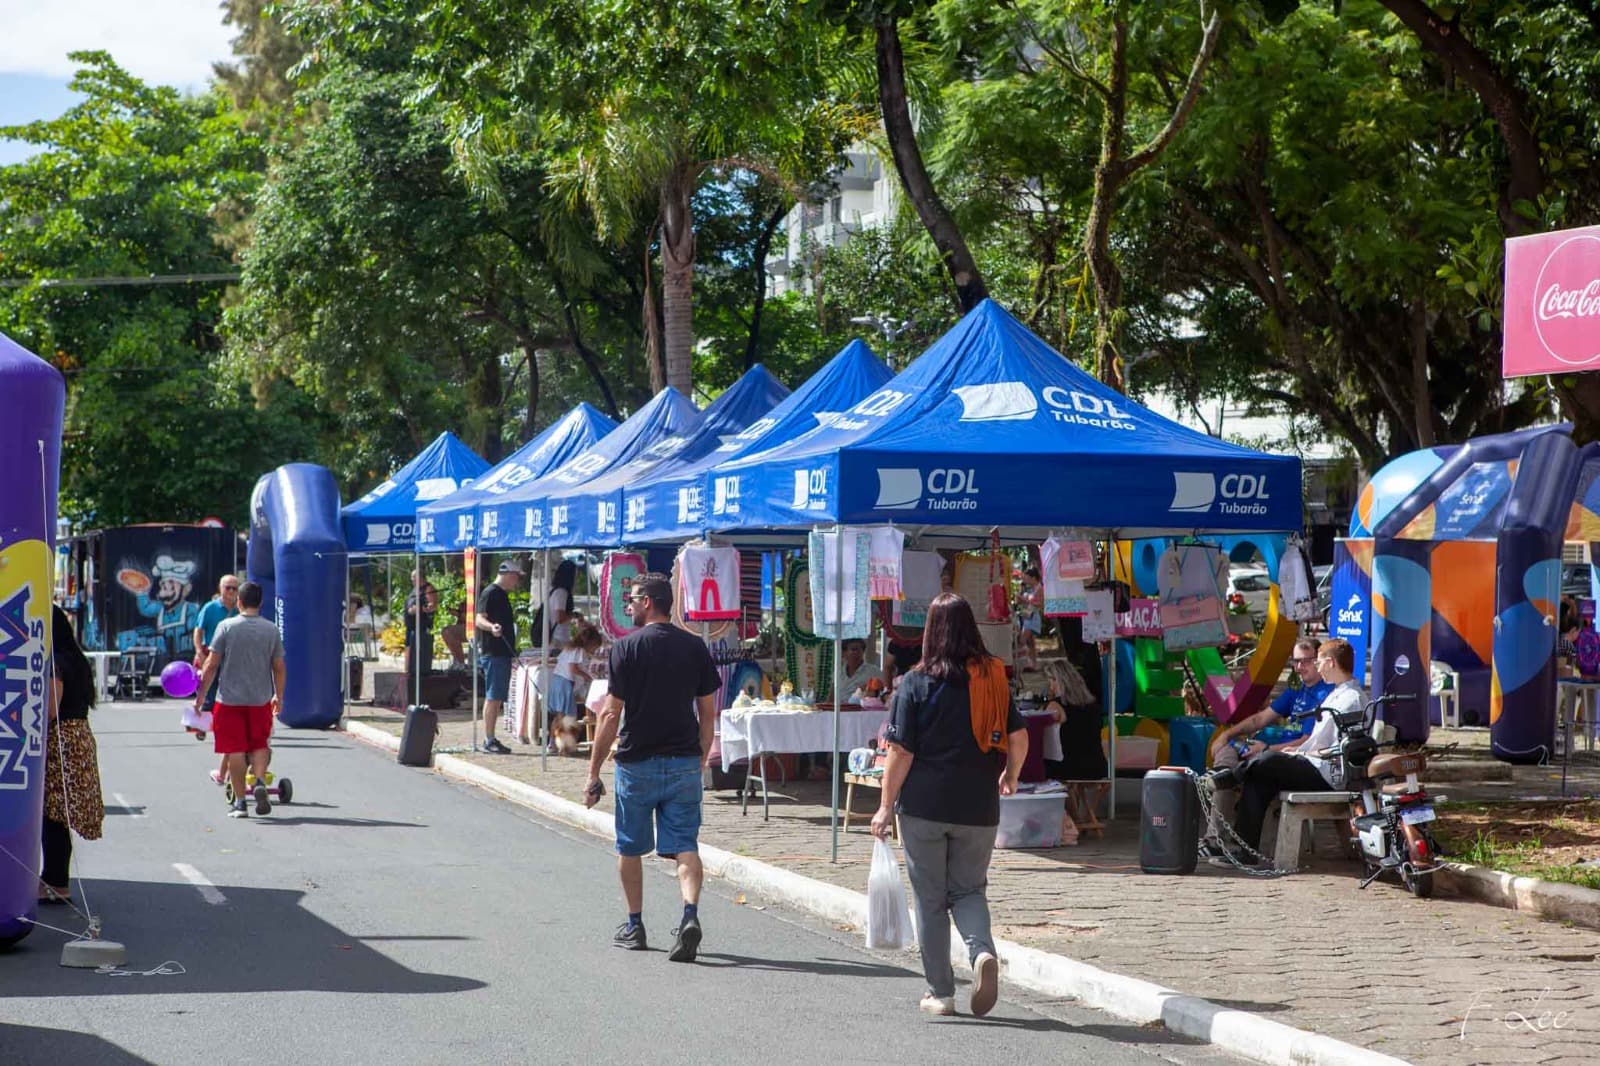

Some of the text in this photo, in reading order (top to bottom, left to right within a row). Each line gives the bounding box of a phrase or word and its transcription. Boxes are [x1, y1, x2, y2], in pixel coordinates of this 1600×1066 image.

[1042, 386, 1132, 418] CDL
[1050, 410, 1136, 431] Tubarão
[810, 470, 827, 494] CDL
[927, 469, 979, 494] CDL
[1220, 473, 1270, 499] CDL
[927, 498, 977, 510] Tubarão
[1219, 502, 1267, 514] Tubarão
